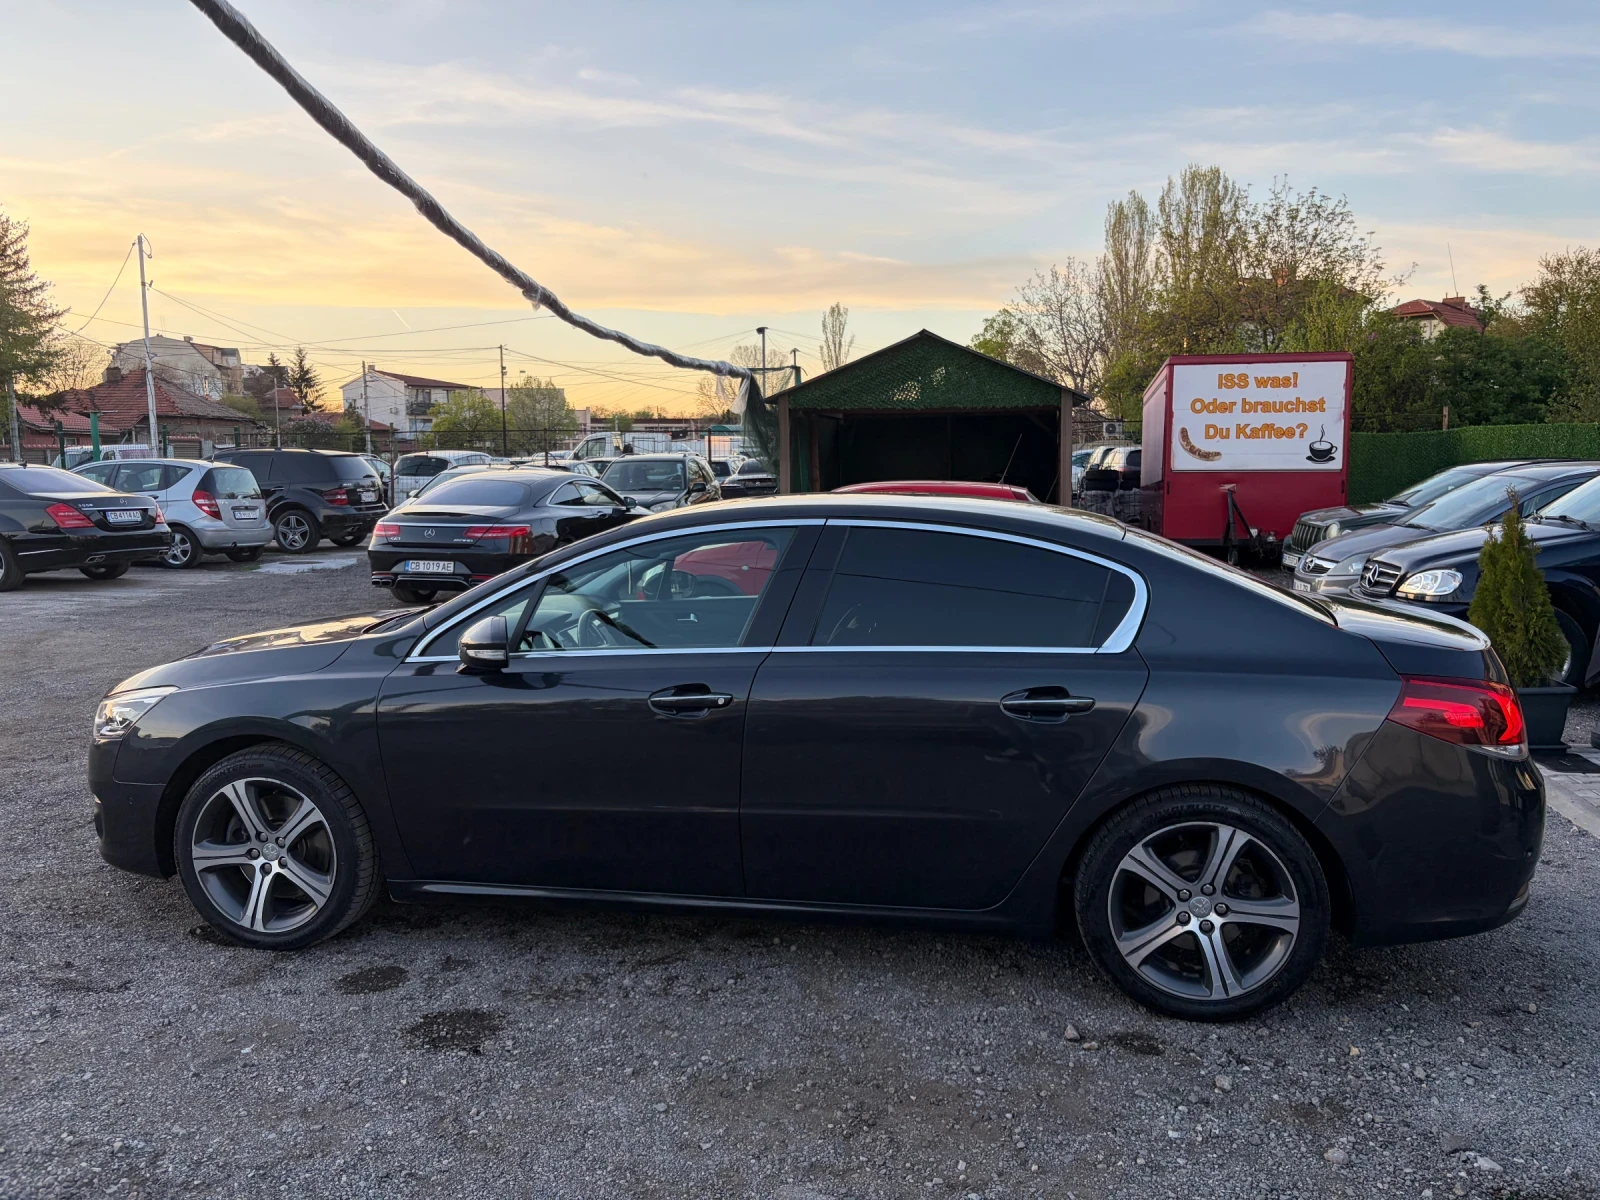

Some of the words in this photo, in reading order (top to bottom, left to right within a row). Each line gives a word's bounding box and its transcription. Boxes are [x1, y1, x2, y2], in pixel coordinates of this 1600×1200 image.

[1217, 373, 1249, 389] ISS
[1254, 372, 1299, 389] was!
[1190, 397, 1237, 414] Oder
[1241, 396, 1326, 414] brauchst
[1204, 424, 1230, 440] Du
[1235, 423, 1308, 440] Kaffee?
[410, 561, 420, 570] CB
[422, 562, 440, 571] 1019
[441, 562, 452, 571] AE
